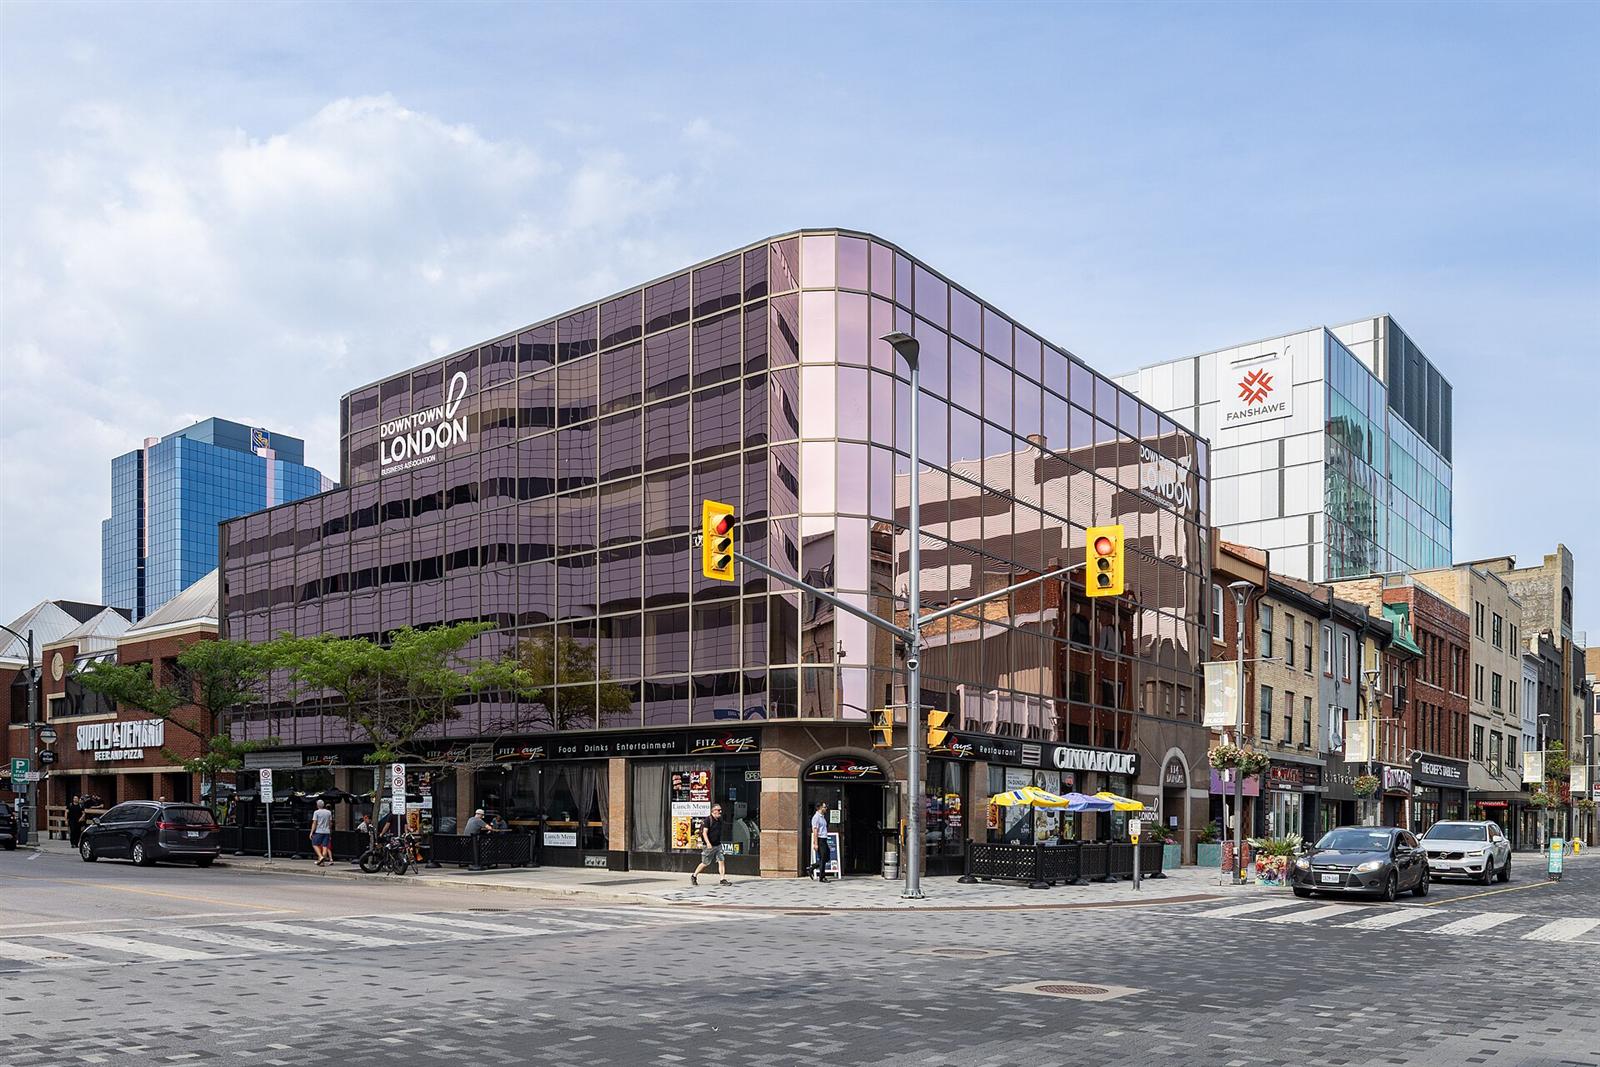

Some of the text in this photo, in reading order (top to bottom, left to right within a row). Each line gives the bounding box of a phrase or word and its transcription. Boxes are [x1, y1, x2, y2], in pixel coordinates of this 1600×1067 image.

[1226, 402, 1286, 421] FANSHAWE
[381, 406, 444, 437] DOWNTOWN
[381, 416, 467, 465] LONDON
[381, 455, 436, 476] BUSINESS ASSOCIATION
[77, 723, 113, 750] SUPPLY
[120, 719, 164, 748] DEMAND
[584, 744, 608, 752] Drinks
[617, 741, 675, 751] Entertainment
[980, 745, 1016, 756] Restaurant
[111, 750, 123, 760] AND
[124, 749, 144, 760] PIZZA
[1054, 746, 1136, 775] CINNAHOLIC
[16, 760, 25, 769] P
[1169, 765, 1179, 774] 114
[1421, 761, 1430, 774] THE
[1429, 763, 1442, 776] CHEF'S
[1139, 812, 1158, 821] LONDON
